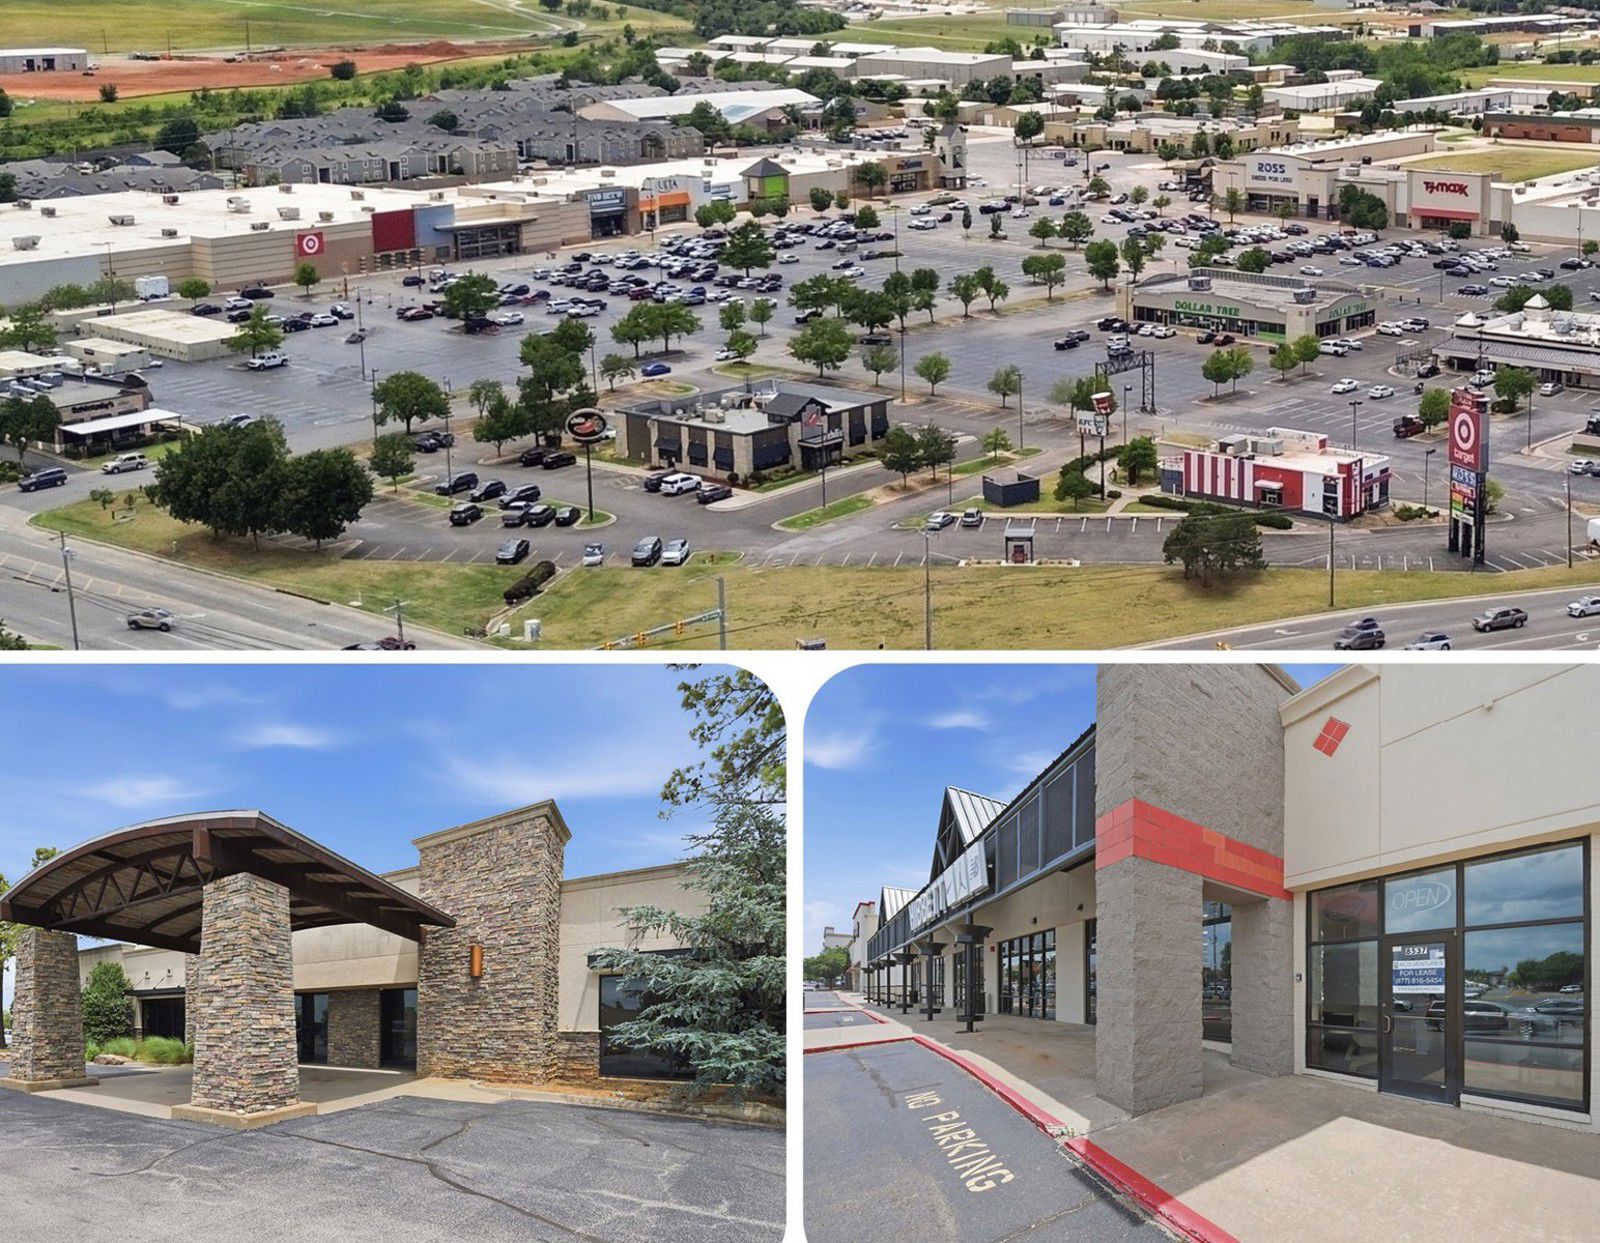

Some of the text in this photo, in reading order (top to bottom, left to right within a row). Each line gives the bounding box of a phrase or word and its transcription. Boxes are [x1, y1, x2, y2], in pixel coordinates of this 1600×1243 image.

[1257, 163, 1286, 174] ROSS
[1175, 300, 1240, 317] DOLLAR TREE
[1393, 888, 1439, 909] OPEN
[1405, 947, 1427, 955] 8537
[1399, 968, 1437, 977] FOR LEASE
[904, 1090, 941, 1109] NO
[922, 1110, 1015, 1192] PARKING
